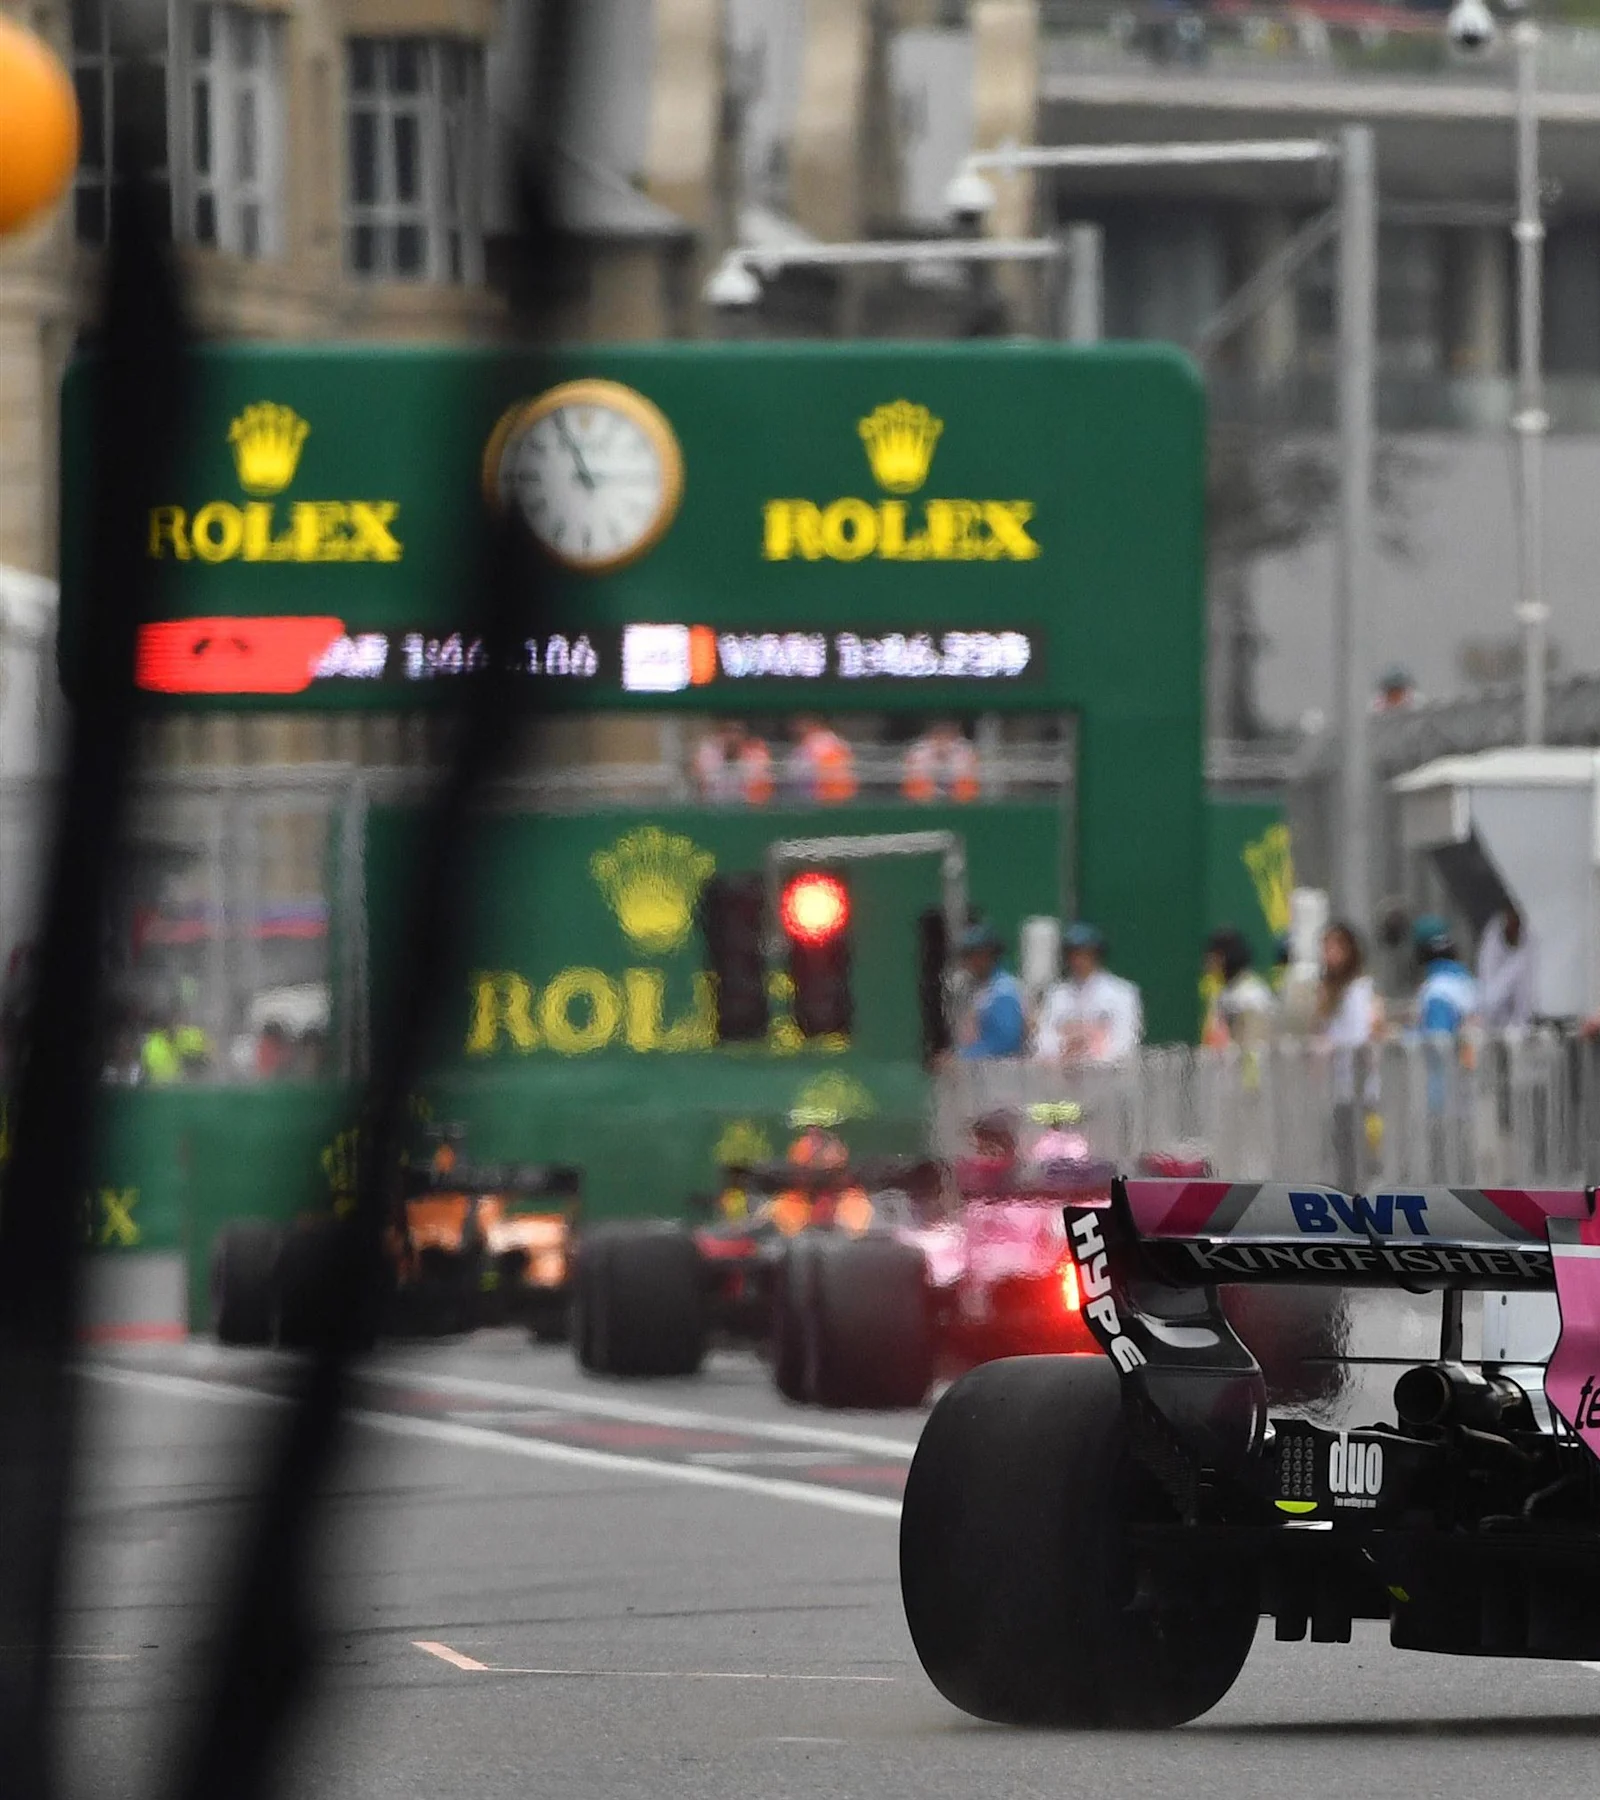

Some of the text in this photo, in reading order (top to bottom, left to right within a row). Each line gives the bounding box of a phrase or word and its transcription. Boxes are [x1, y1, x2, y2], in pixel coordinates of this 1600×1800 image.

[148, 500, 401, 562] ROLEX
[762, 498, 1040, 562] ROLEX
[465, 964, 852, 1058] ROL
[1288, 1192, 1431, 1236] BWT
[1071, 1211, 1148, 1374] HYPE
[1182, 1242, 1553, 1279] KINGFISHER
[1328, 1432, 1383, 1496] duo
